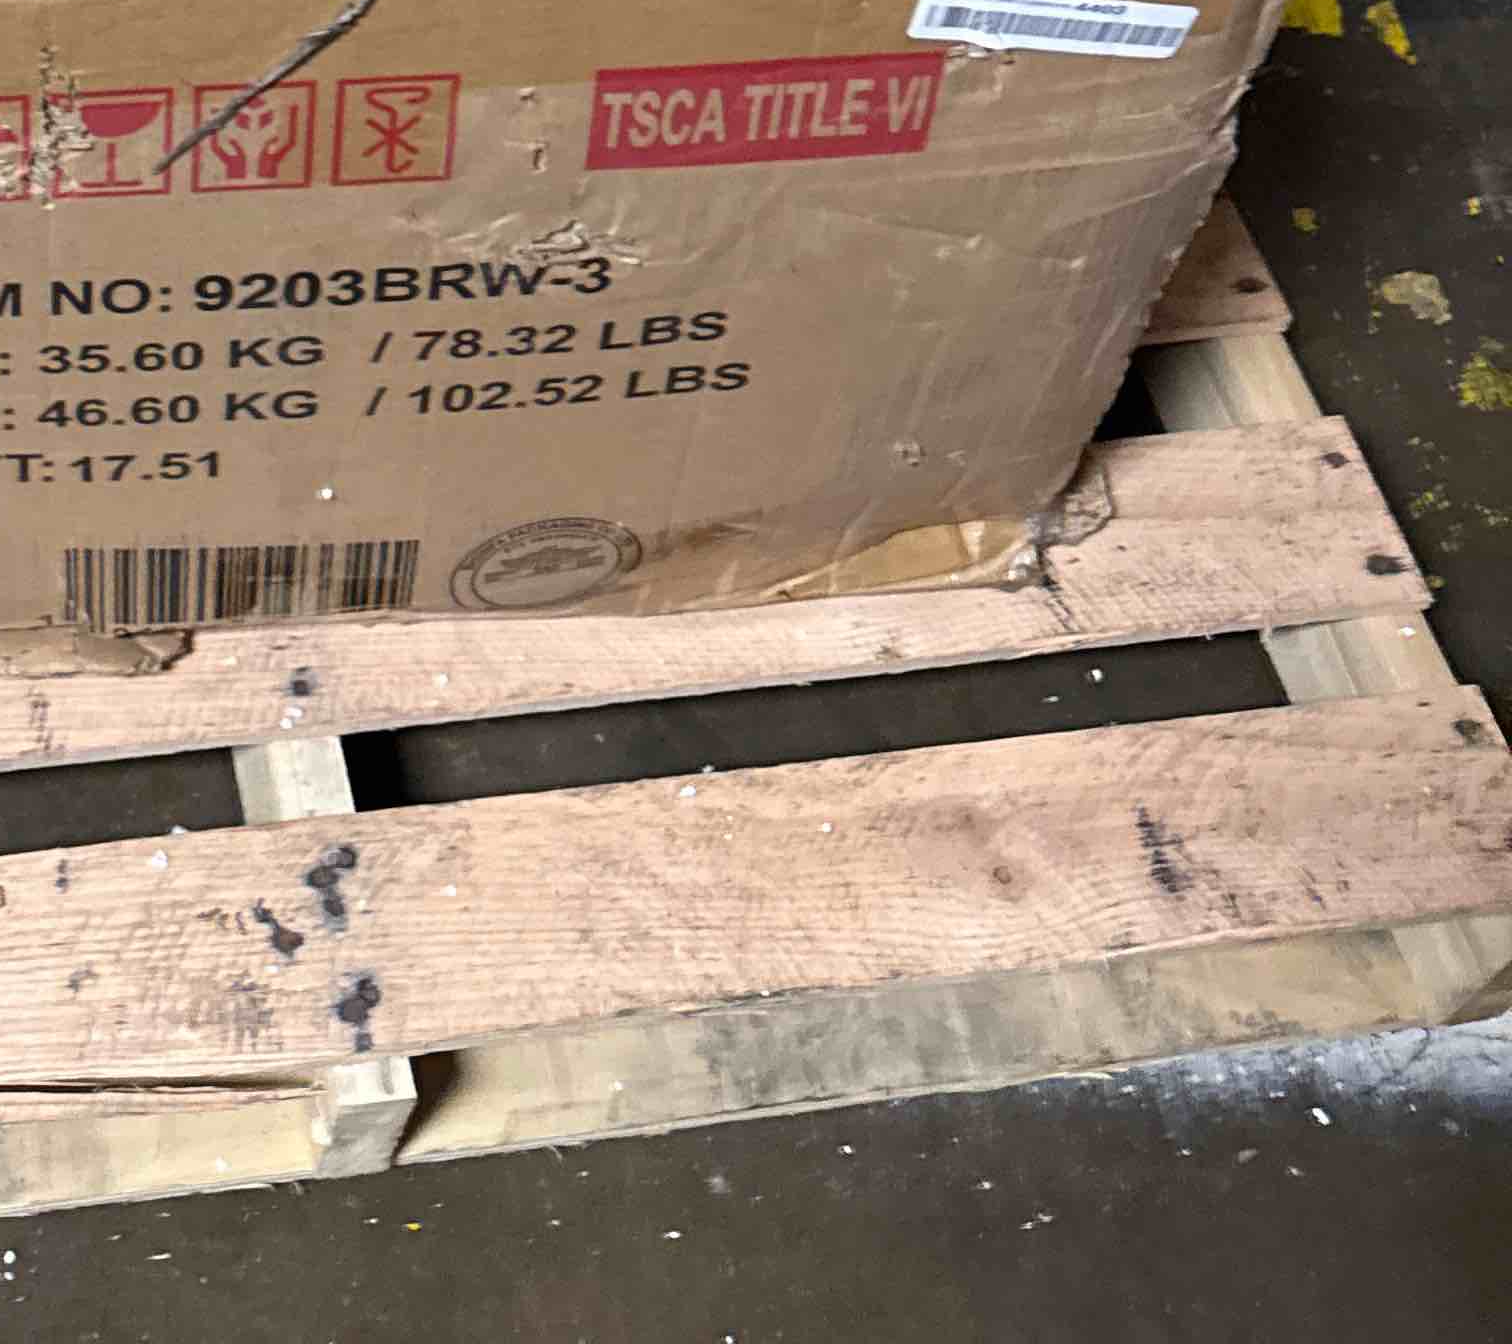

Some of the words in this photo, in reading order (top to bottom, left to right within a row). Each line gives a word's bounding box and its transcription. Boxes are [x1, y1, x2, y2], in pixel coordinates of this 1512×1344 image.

[601, 88, 727, 150] TSCA
[743, 79, 875, 141] TITLE
[886, 75, 932, 132] VI
[50, 278, 174, 315] NO:
[193, 256, 614, 313] 9203BRW-3
[38, 340, 205, 375] 35.60
[229, 335, 326, 368] KG
[413, 323, 579, 361] 78.32
[599, 311, 730, 351] LBS
[36, 394, 201, 428] 46.60
[224, 389, 320, 421] KG
[408, 373, 605, 415] 102.52
[624, 361, 753, 399] LBS
